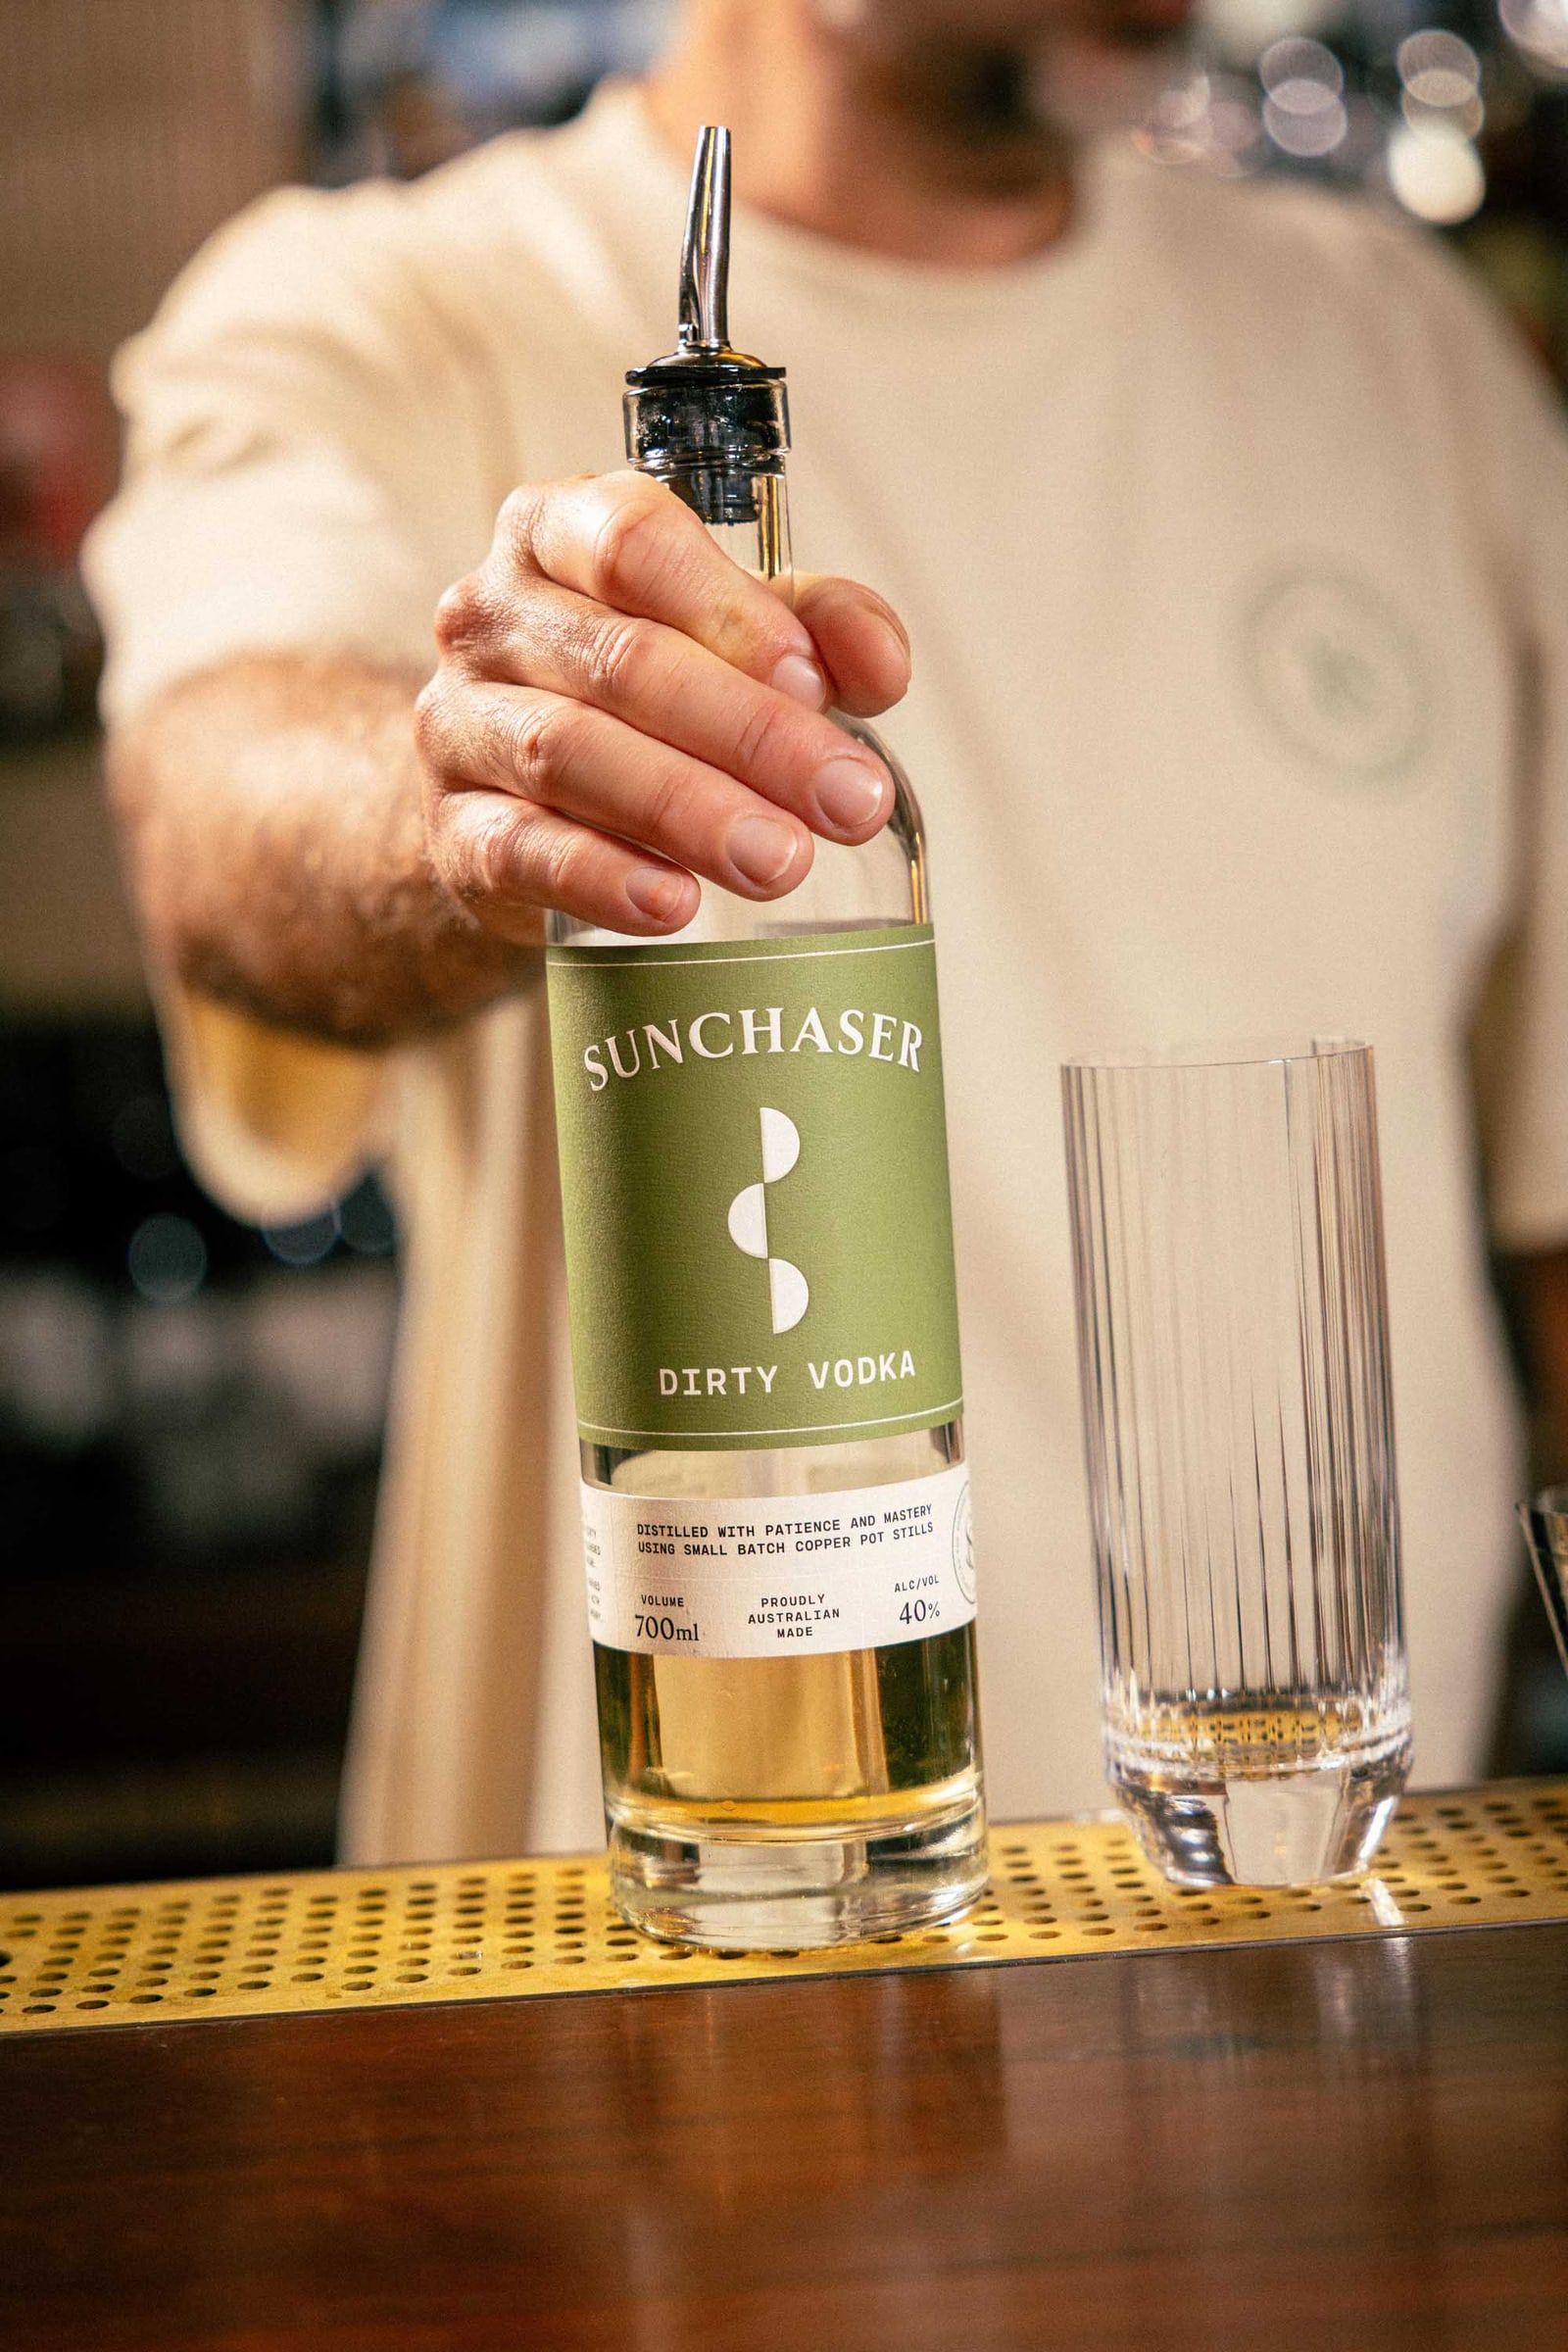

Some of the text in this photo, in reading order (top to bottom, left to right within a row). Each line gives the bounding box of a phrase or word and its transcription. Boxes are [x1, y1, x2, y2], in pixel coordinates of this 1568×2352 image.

[583, 1006, 922, 1092] SUNCHASER
[659, 1349, 916, 1396] DIRTY VODKA
[637, 1503, 932, 1538] DISTILLED WITH PATIENCE AND MASTERY
[638, 1521, 934, 1556] USING SMALL BATCH COPPER POT STILLS
[894, 1574, 941, 1593] ALC/VOL
[641, 1594, 685, 1608] VOLUME
[760, 1593, 826, 1608] PROUDLY
[899, 1598, 942, 1626] 40%
[634, 1614, 700, 1642] 700ml
[748, 1608, 841, 1625] AUSTRALIAN
[777, 1627, 813, 1640] MADE
